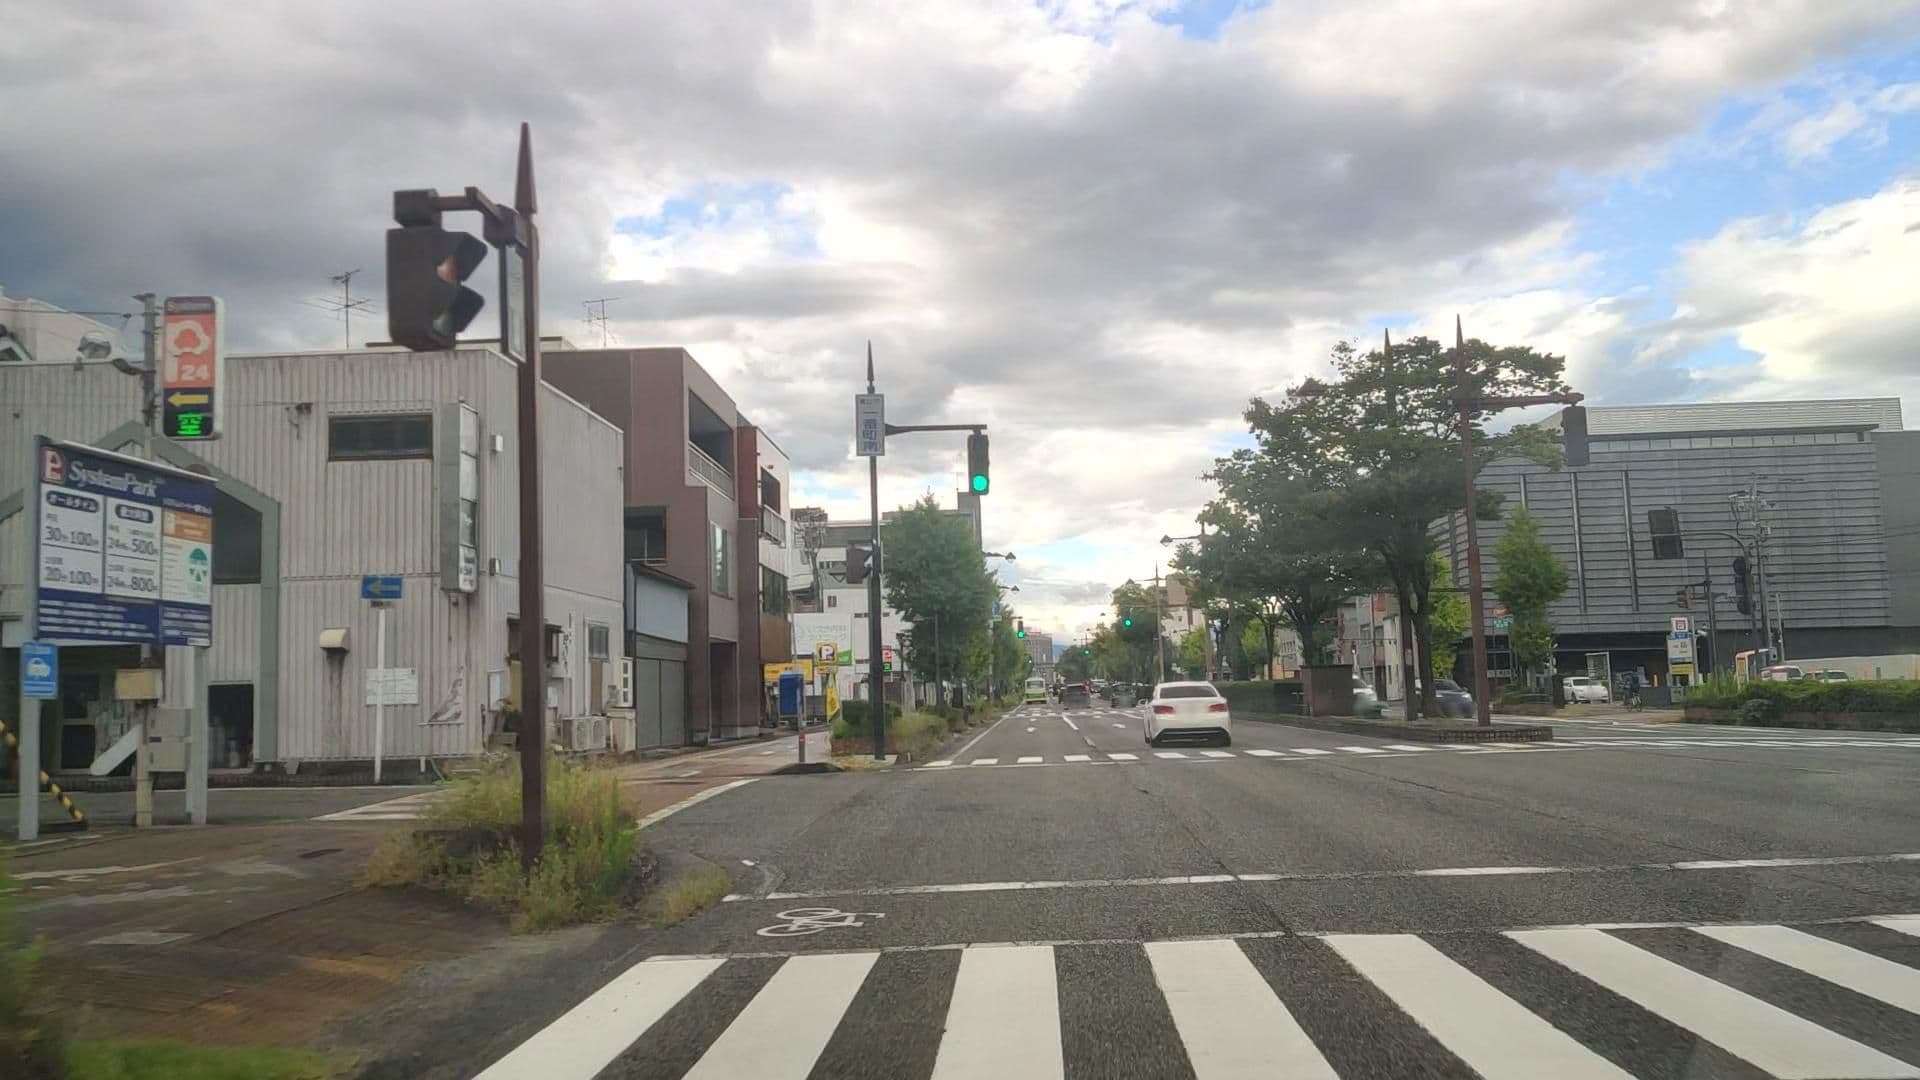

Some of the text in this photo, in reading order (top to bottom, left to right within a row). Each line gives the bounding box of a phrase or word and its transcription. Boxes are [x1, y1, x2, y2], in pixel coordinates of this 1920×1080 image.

[181, 364, 209, 381] 24
[68, 459, 157, 498] SystemPark
[821, 644, 835, 661] P
